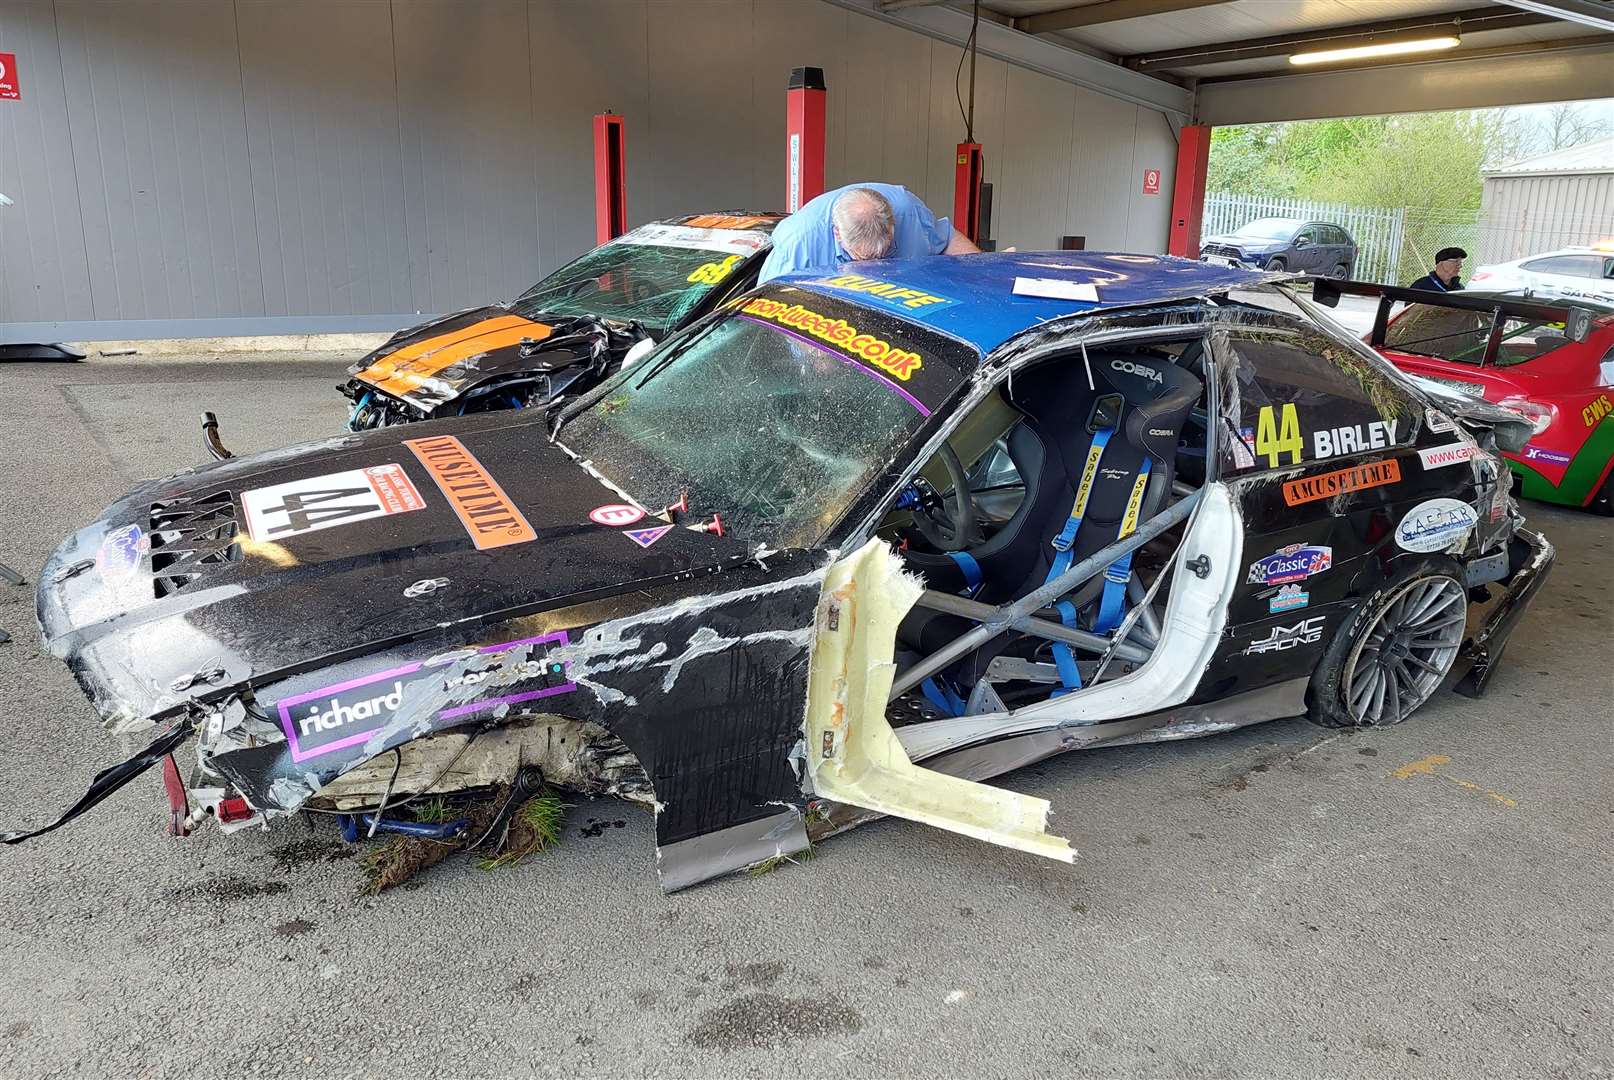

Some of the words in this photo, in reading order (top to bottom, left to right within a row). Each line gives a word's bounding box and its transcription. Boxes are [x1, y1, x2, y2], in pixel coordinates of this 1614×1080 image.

[1111, 359, 1163, 384] COBRA
[1582, 395, 1612, 427] CWS
[1149, 428, 1174, 436] COBRA
[1256, 402, 1303, 468] 44
[1314, 419, 1397, 459] BIRLEY
[1076, 452, 1099, 513] Sabelt
[1290, 463, 1393, 502] AMUSETIME
[262, 487, 381, 535] 44
[600, 508, 635, 520] E
[1267, 555, 1308, 575] Classic
[1246, 631, 1322, 656] RACING
[1251, 615, 1326, 645] JMC
[299, 682, 402, 737] richard
